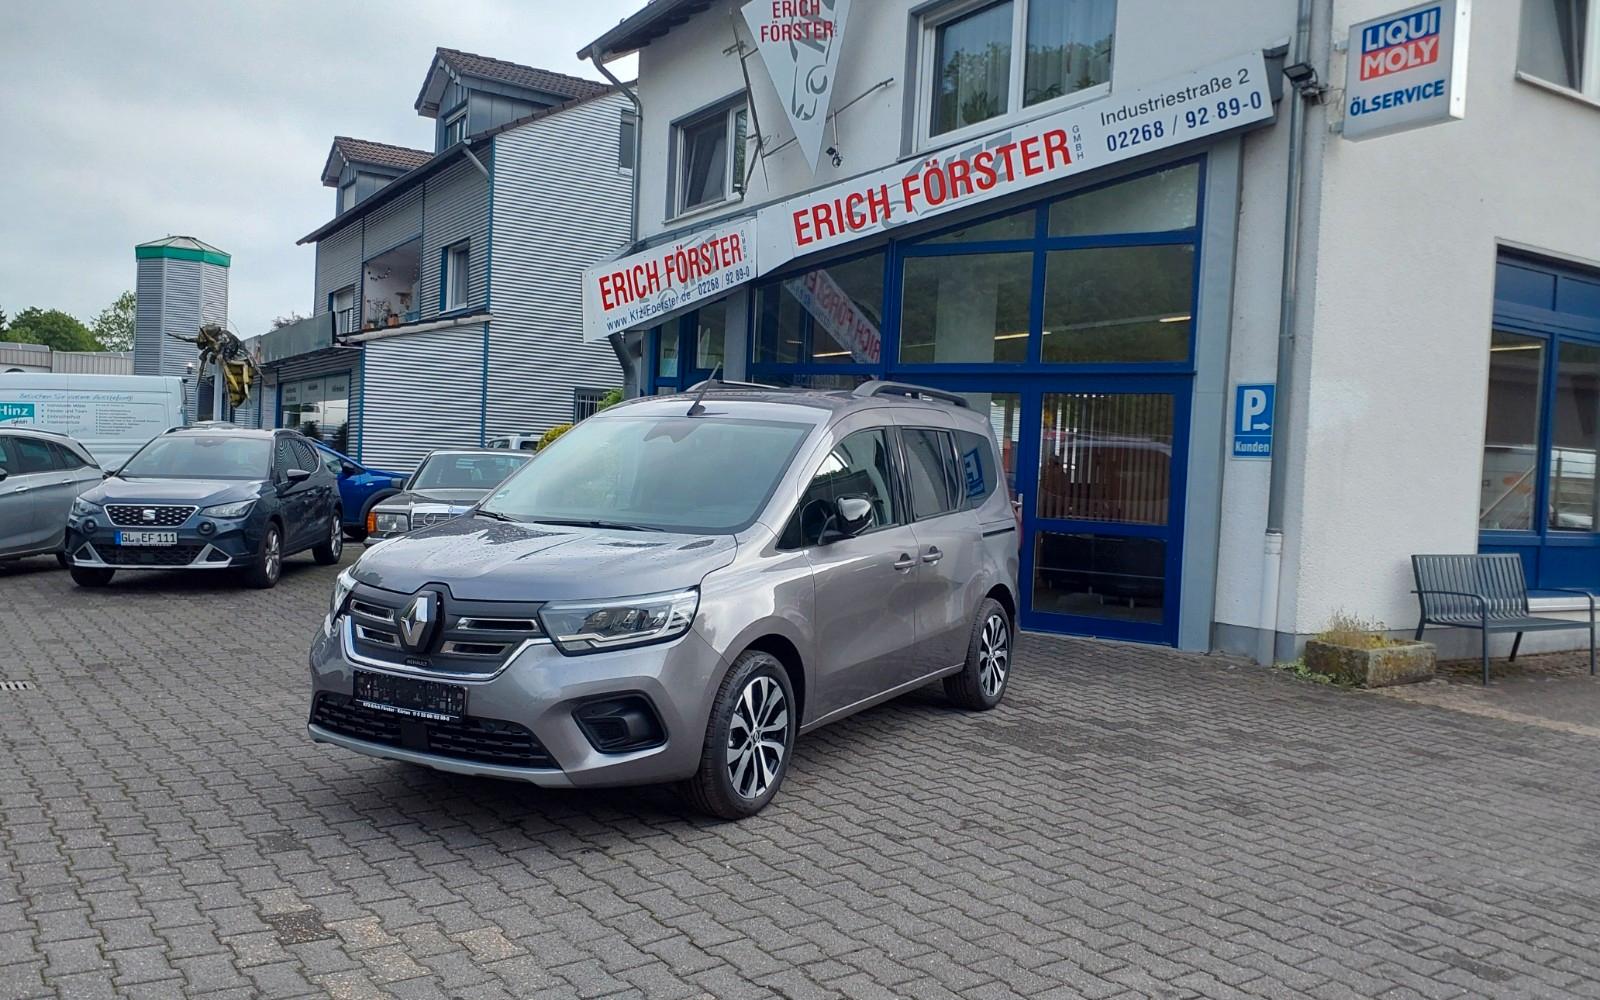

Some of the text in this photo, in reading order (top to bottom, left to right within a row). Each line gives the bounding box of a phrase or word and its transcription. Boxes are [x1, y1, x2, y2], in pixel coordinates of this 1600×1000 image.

[771, 0, 820, 18] ERICH
[761, 20, 833, 43] FÖRSTER
[1366, 10, 1437, 51] LIQUI
[1364, 37, 1437, 78] MOLY
[1100, 68, 1250, 126] Industriestraße 2
[1350, 80, 1445, 116] ÖLSERVICE
[1106, 120, 1164, 152] 02268
[1185, 107, 1209, 128] 92
[1217, 91, 1262, 120] 89-0
[793, 128, 1072, 247] ERICH FÖRSTER
[598, 233, 742, 311] ERICH FÖRSTER
[697, 279, 720, 296] 02268
[725, 271, 734, 285] 92
[736, 266, 750, 281] 89-0
[0, 404, 29, 416] Hinz
[1242, 389, 1267, 432] P
[1235, 441, 1270, 453] Kunden
[121, 533, 177, 543] GL EF 111
